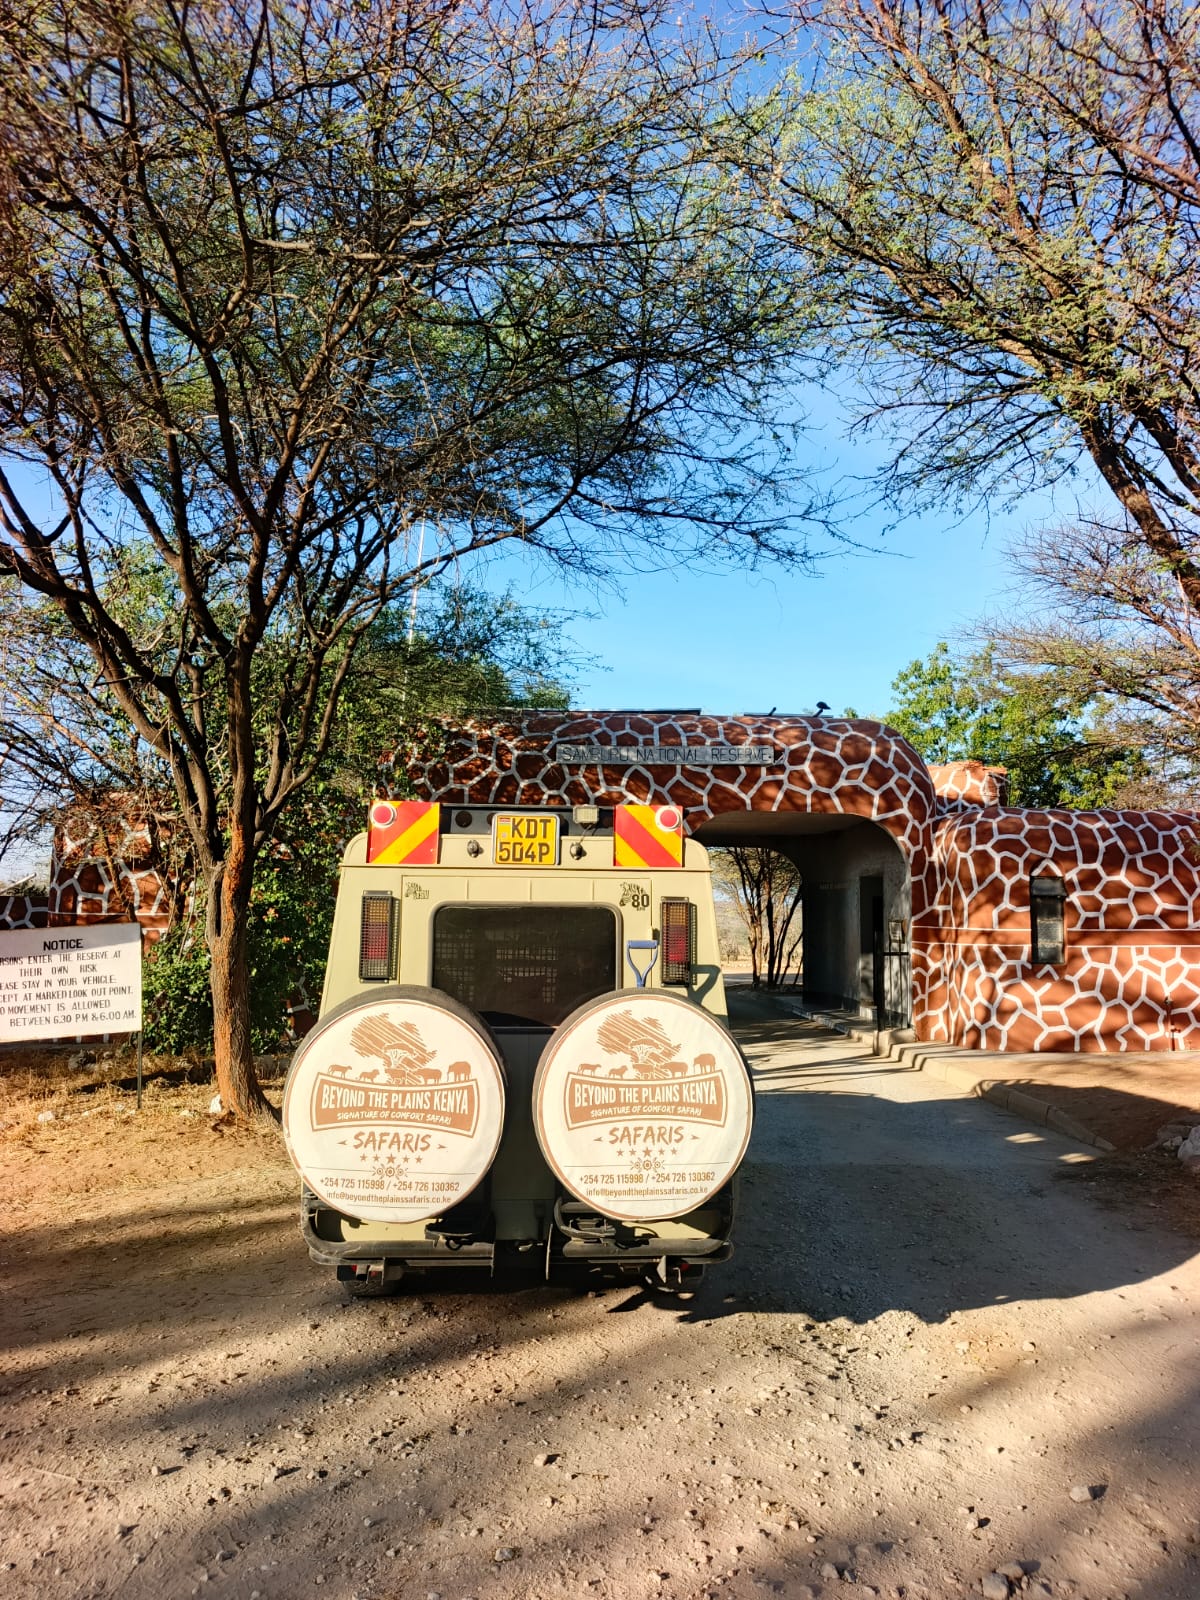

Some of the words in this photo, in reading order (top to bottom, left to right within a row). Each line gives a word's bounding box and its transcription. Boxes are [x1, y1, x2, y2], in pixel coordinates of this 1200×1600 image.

[636, 748, 699, 762] NATIONAL
[511, 817, 552, 839] KDT
[498, 841, 550, 863] 504P
[631, 893, 650, 908] 80
[43, 938, 84, 951] NOTICE
[27, 954, 53, 965] ENTER
[59, 952, 73, 963] THE
[76, 950, 109, 961] RESERVE
[113, 949, 121, 959] AT
[19, 967, 42, 977] THEIR
[51, 965, 69, 975] OWN
[79, 963, 98, 973] RISK
[22, 979, 40, 989] STAY
[44, 978, 52, 988] IN
[57, 976, 78, 987] YOUR
[23, 992, 33, 1002] AT
[35, 990, 67, 1001] MARKED
[68, 988, 88, 999] LOOK
[91, 986, 106, 997] OUT
[8, 1003, 52, 1015] MOVEMENT
[57, 1001, 66, 1012] IS
[71, 999, 111, 1011] ALLOWED
[9, 1016, 51, 1028] BETWEEN
[321, 1084, 365, 1109] BEYOND
[368, 1091, 388, 1109] THE
[391, 1092, 431, 1111] PLAINS
[433, 1089, 469, 1115] KENYA
[575, 1083, 616, 1108] BEYOND
[619, 1087, 639, 1104] THE
[642, 1084, 680, 1104] PLAINS
[682, 1080, 717, 1105] KENYA
[336, 1110, 379, 1121] SIGNATURE
[379, 1110, 390, 1119] OF
[390, 1111, 425, 1121] COMFORT
[425, 1113, 452, 1125] SAFARI
[590, 1106, 630, 1118] SIGNATURE
[631, 1105, 641, 1113] OF
[642, 1105, 675, 1113] COMFORT
[677, 1107, 702, 1116] SAFARI
[352, 1131, 432, 1153] SAFARIS
[608, 1126, 685, 1146] SAFARIS
[320, 1177, 339, 1188] +254
[341, 1178, 355, 1189] 725
[358, 1179, 385, 1191] 115998
[393, 1181, 413, 1192] +254
[415, 1182, 429, 1192] 726
[431, 1181, 460, 1193] 130362
[580, 1174, 598, 1184] +254
[601, 1174, 615, 1184] 725
[617, 1173, 644, 1184] 115998
[652, 1172, 670, 1183] +254
[672, 1172, 686, 1182] 726
[689, 1171, 716, 1182] 130362
